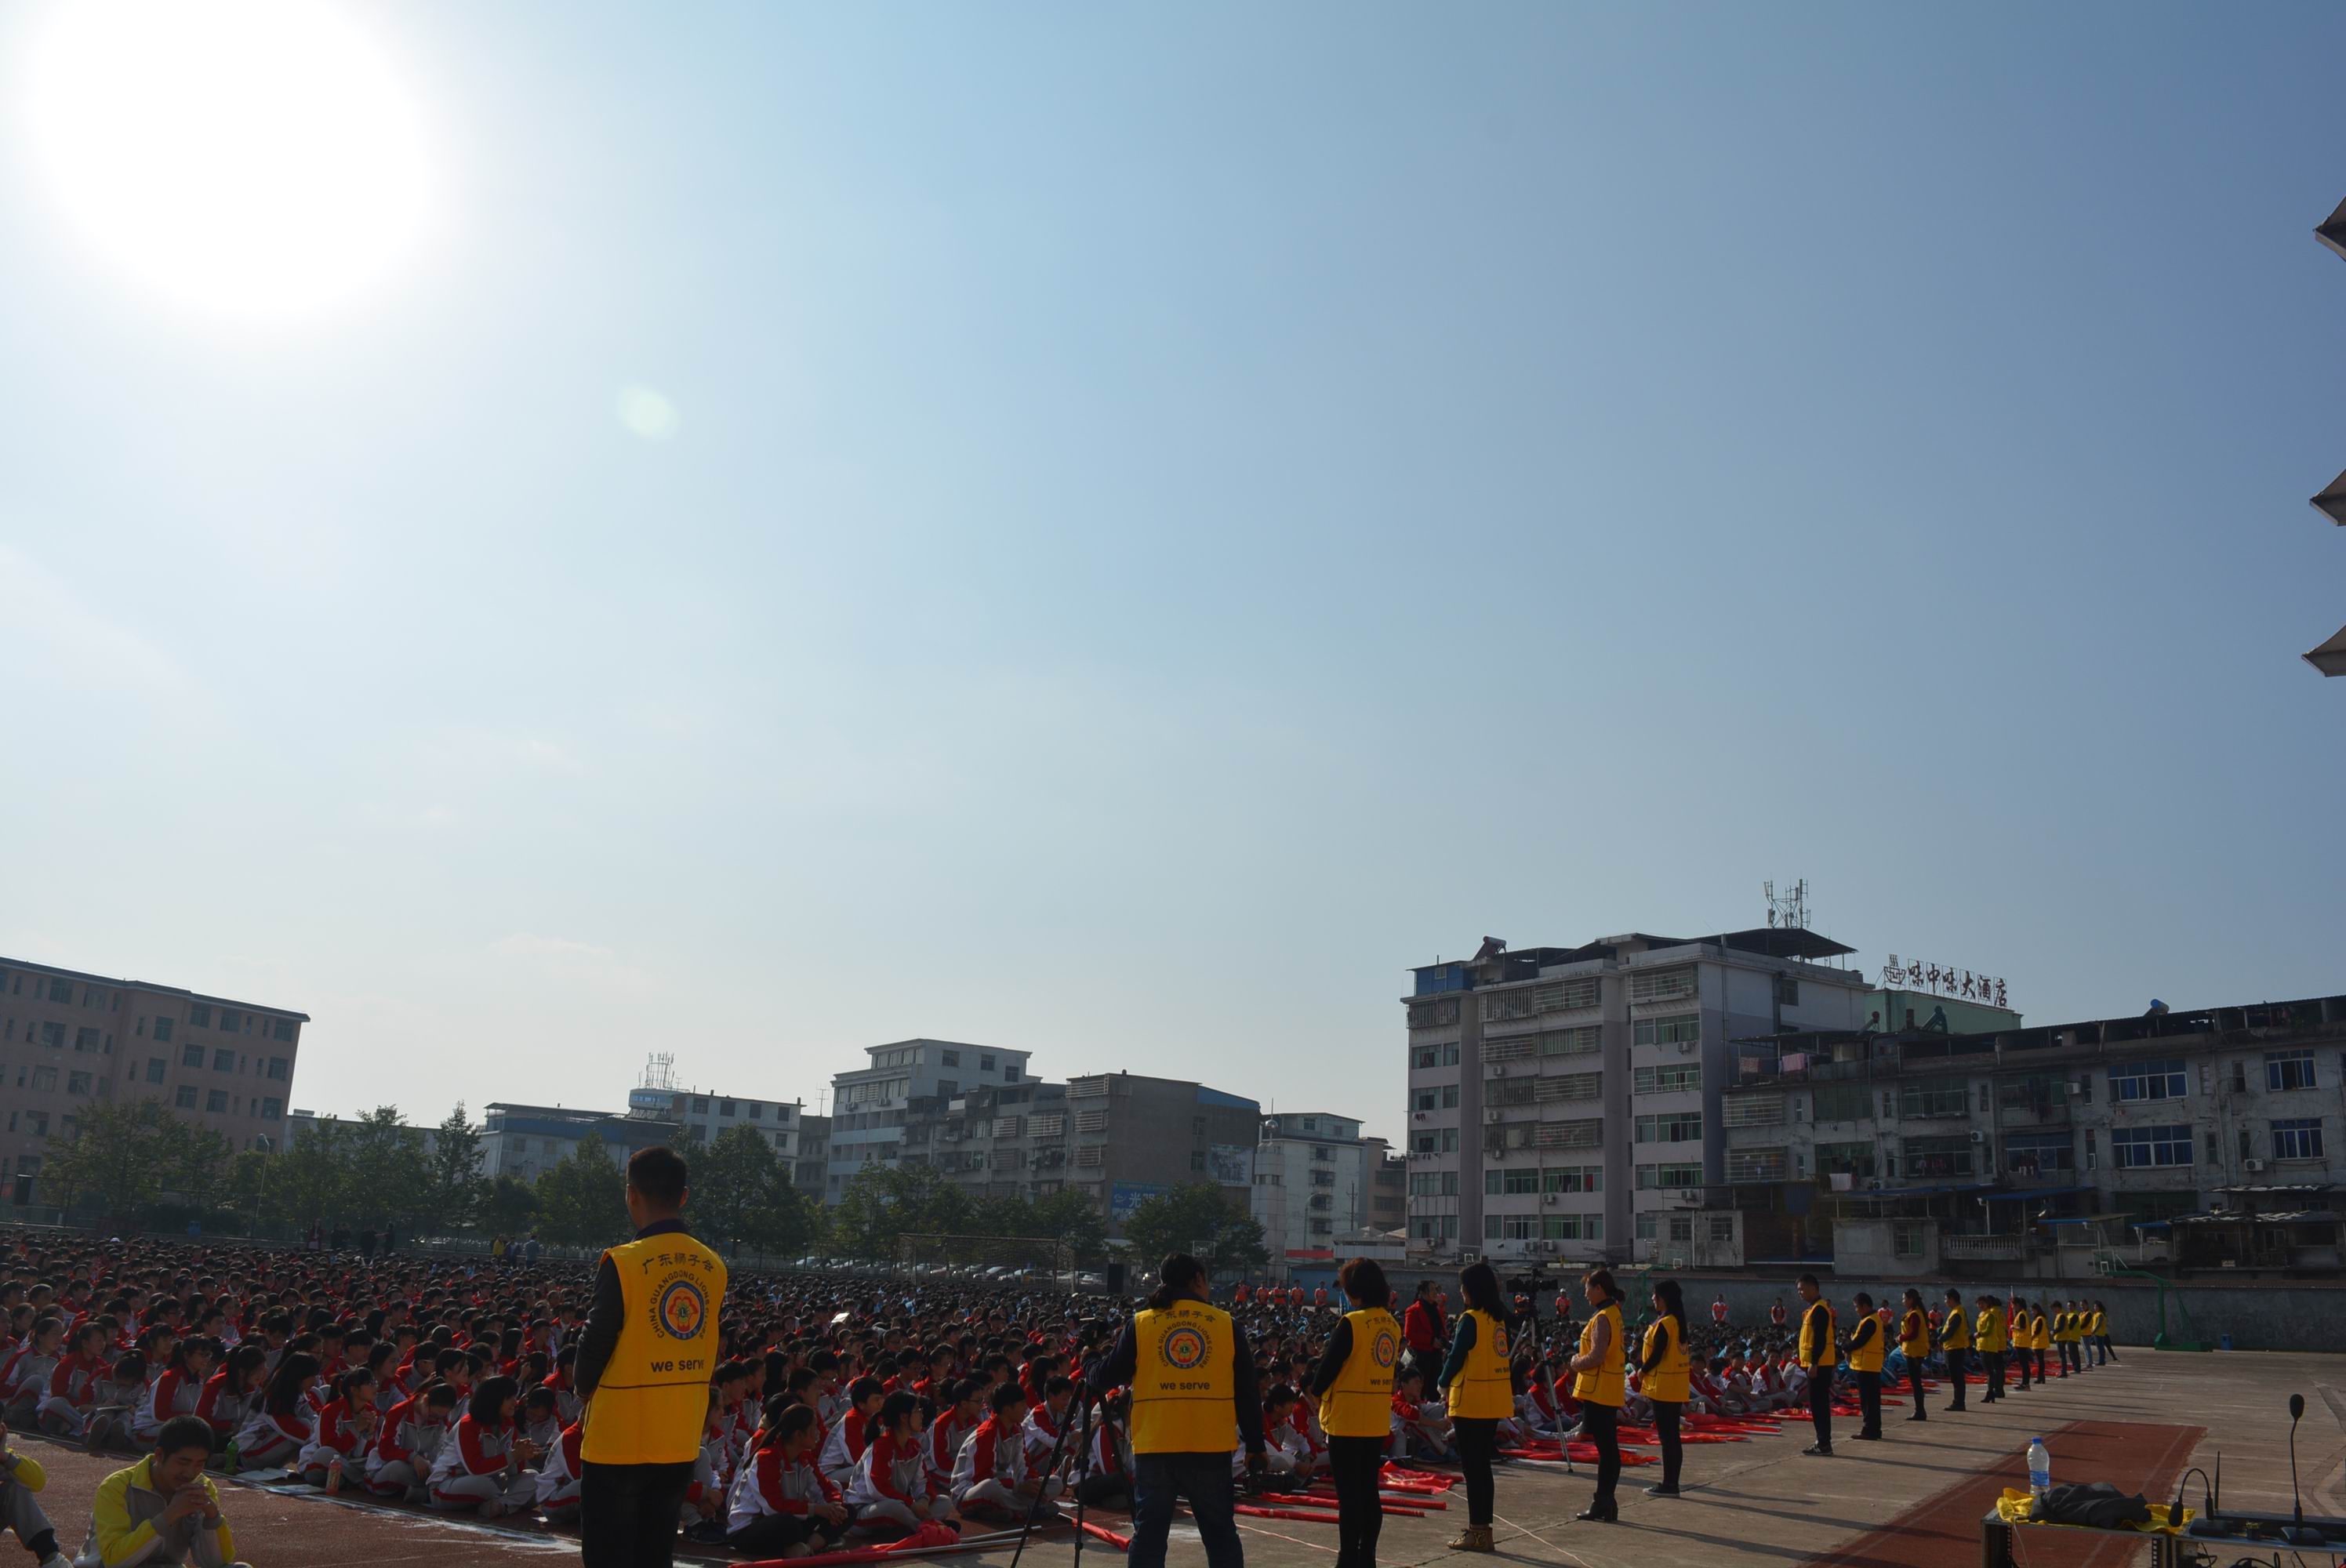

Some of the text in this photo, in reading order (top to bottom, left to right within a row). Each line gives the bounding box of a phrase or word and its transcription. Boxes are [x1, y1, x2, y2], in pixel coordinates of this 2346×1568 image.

[1908, 960, 2007, 1007] 味中味大酒店
[642, 1252, 714, 1275] 广东狮子会
[650, 1269, 695, 1305] GUANGDONG
[695, 1277, 710, 1305] LIONS
[649, 1307, 665, 1339] CHINA
[1153, 1309, 1216, 1324] 广东狮子会
[1157, 1320, 1212, 1369] CHINA GUANGDONG LIONS CLUBS
[651, 1360, 674, 1373] we
[1179, 1381, 1211, 1390] serve
